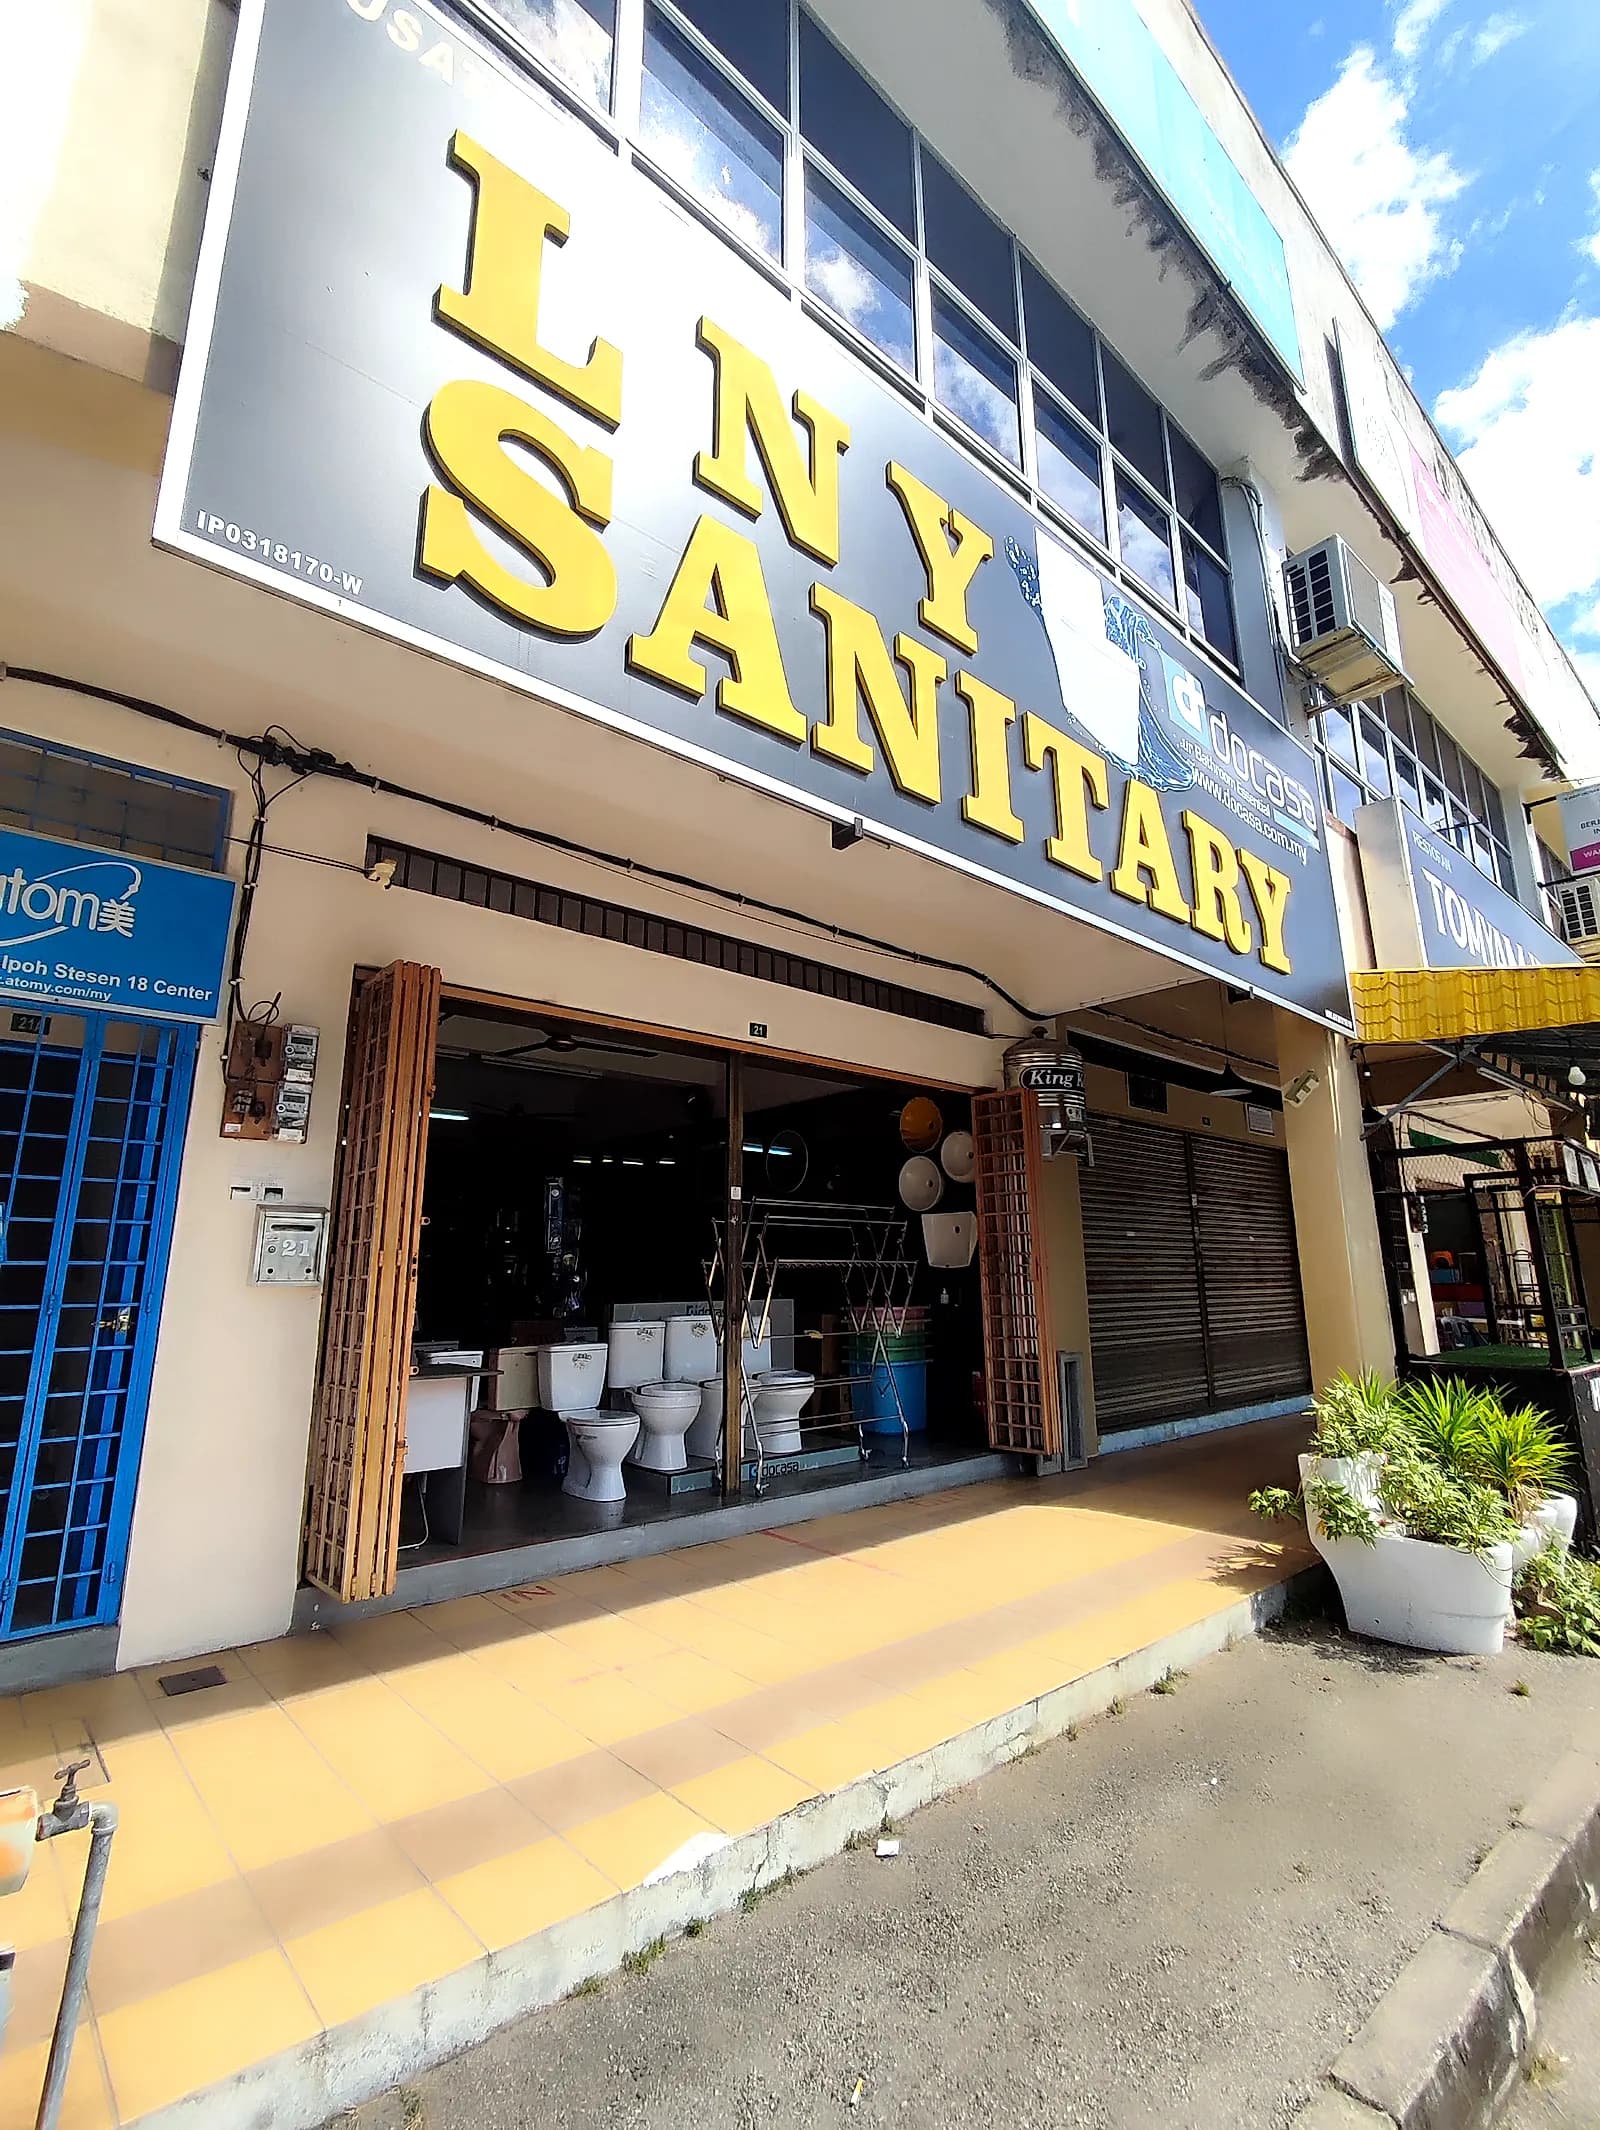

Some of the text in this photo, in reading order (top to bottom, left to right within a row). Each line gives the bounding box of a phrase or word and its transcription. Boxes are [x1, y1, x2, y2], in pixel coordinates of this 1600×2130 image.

[197, 509, 363, 595] IP0318170-W
[412, 379, 1292, 976] SANITARY
[1194, 743, 1236, 791] Bathroom
[1236, 781, 1271, 819] Essential
[1208, 711, 1317, 832] docasa
[1192, 766, 1307, 866] www.docasa.com.my
[0, 975, 112, 1001] .atomy.com/my
[1, 954, 212, 1001] Ipoh Stesen 18 Center
[753, 1025, 763, 1036] 21
[1028, 1069, 1073, 1089] King
[281, 1239, 310, 1257] 21
[761, 1461, 799, 1477] docasa
